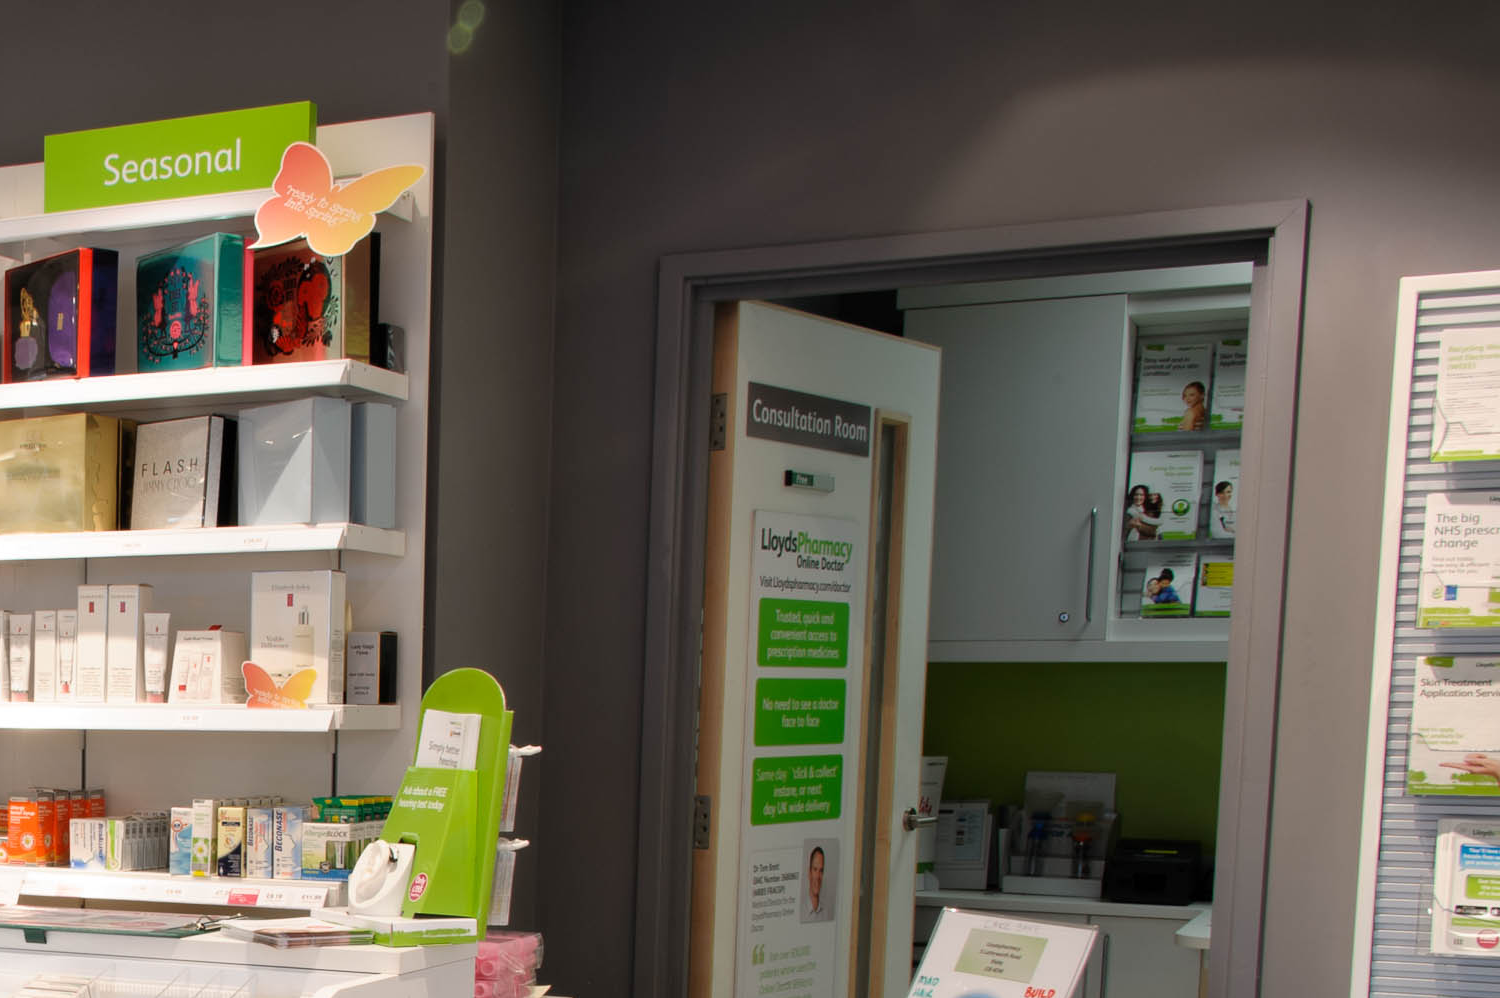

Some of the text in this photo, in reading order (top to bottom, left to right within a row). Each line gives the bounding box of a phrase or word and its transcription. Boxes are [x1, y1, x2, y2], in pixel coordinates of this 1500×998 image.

[104, 138, 241, 186] Seasonal
[752, 399, 867, 442] Consultation Room
[141, 458, 200, 477] FLASH
[1436, 512, 1480, 525] The big
[1434, 525, 1460, 537] NHS
[761, 527, 853, 564] LloydsPharmacy
[1433, 538, 1478, 550] change
[797, 554, 844, 571] Online Doctor
[760, 575, 772, 587] Visit
[803, 611, 835, 625] quick and
[771, 629, 837, 641] convenient access to
[767, 647, 806, 660] prescription
[1420, 678, 1492, 687] Skin Treatment
[1420, 689, 1473, 699] Application
[762, 698, 839, 710] No need to see a doctor
[782, 715, 819, 727] face to face
[756, 769, 774, 781] Same
[775, 768, 787, 781] day
[412, 786, 428, 796] about
[433, 786, 449, 797] FREE
[799, 784, 822, 796] or next
[763, 800, 830, 817] day UK wide delivery
[275, 810, 283, 852] BECONASE
[1024, 986, 1056, 998] BUILD
